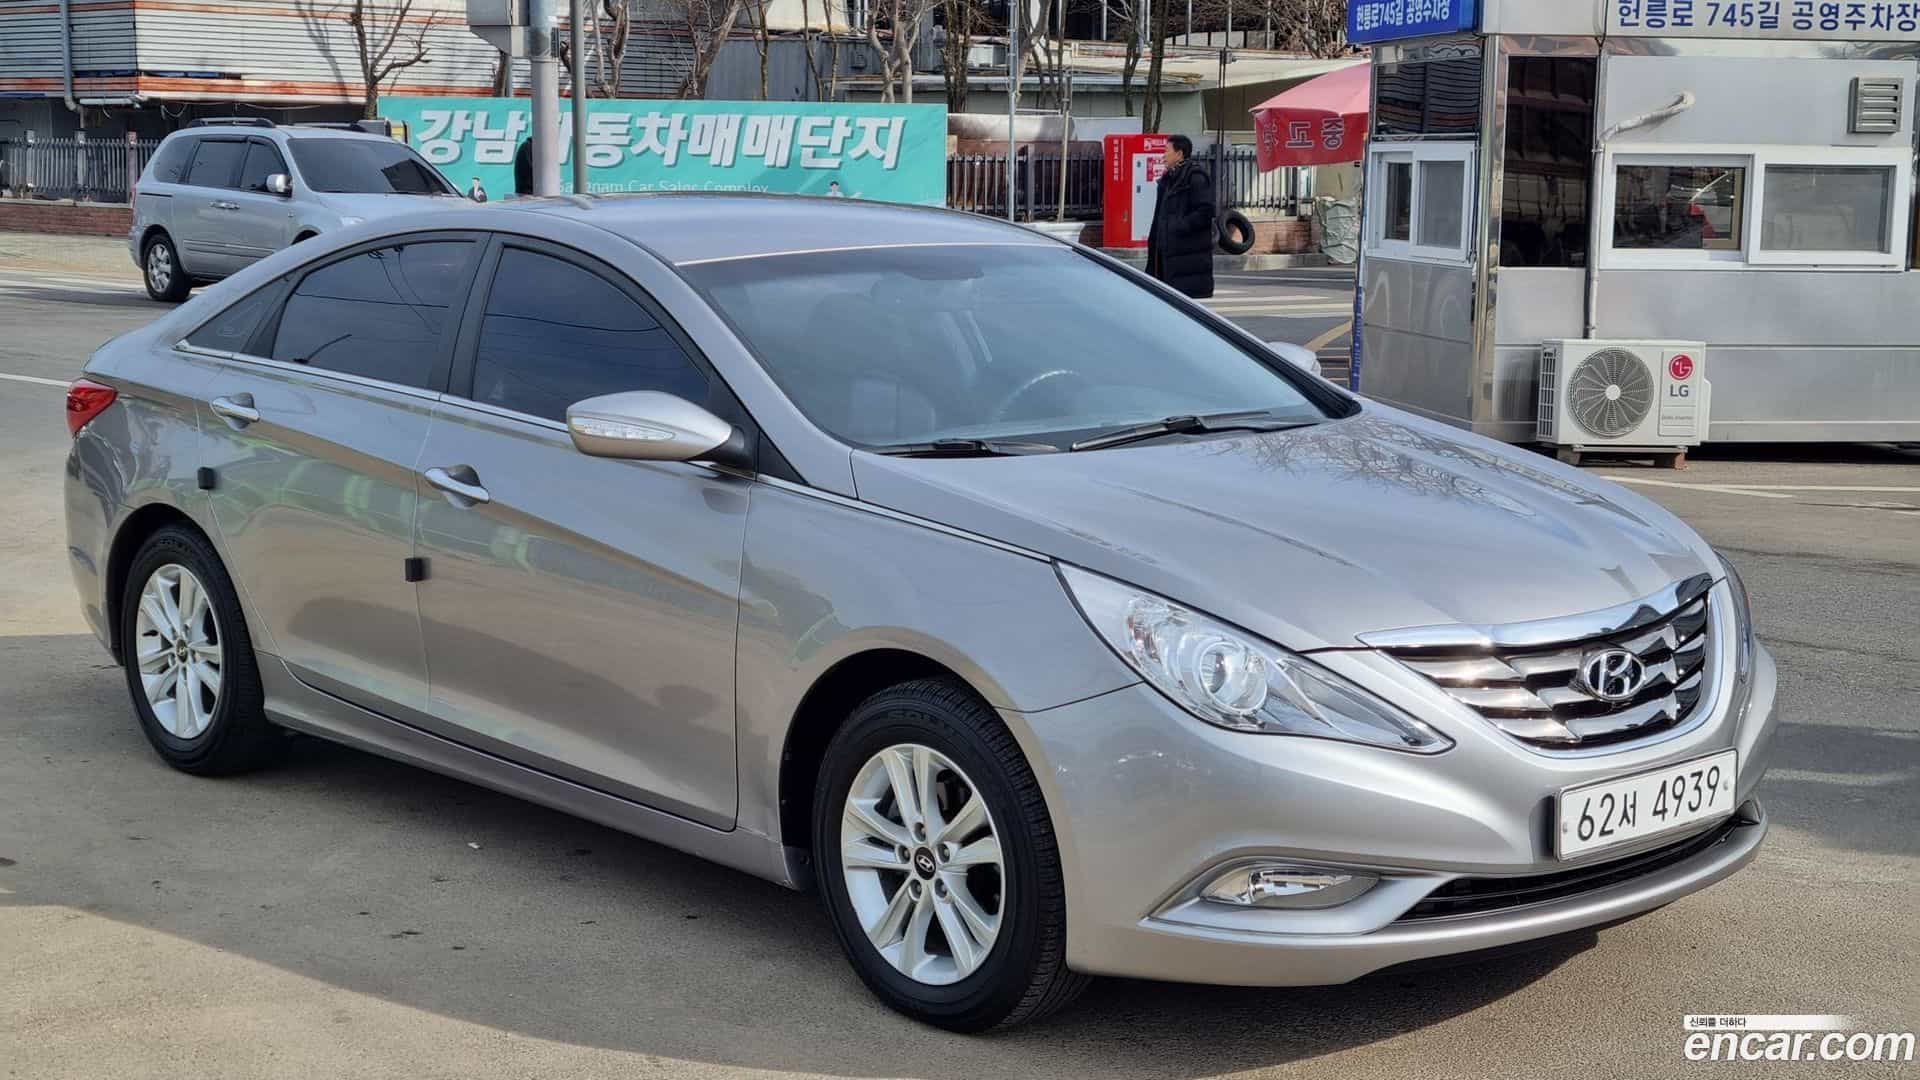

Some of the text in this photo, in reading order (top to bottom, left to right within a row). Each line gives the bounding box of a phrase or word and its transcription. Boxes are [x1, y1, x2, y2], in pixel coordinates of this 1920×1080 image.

[1706, 2, 1780, 29] 745길
[1669, 384, 1689, 397] LG
[1577, 765, 1721, 842] 62서 4939
